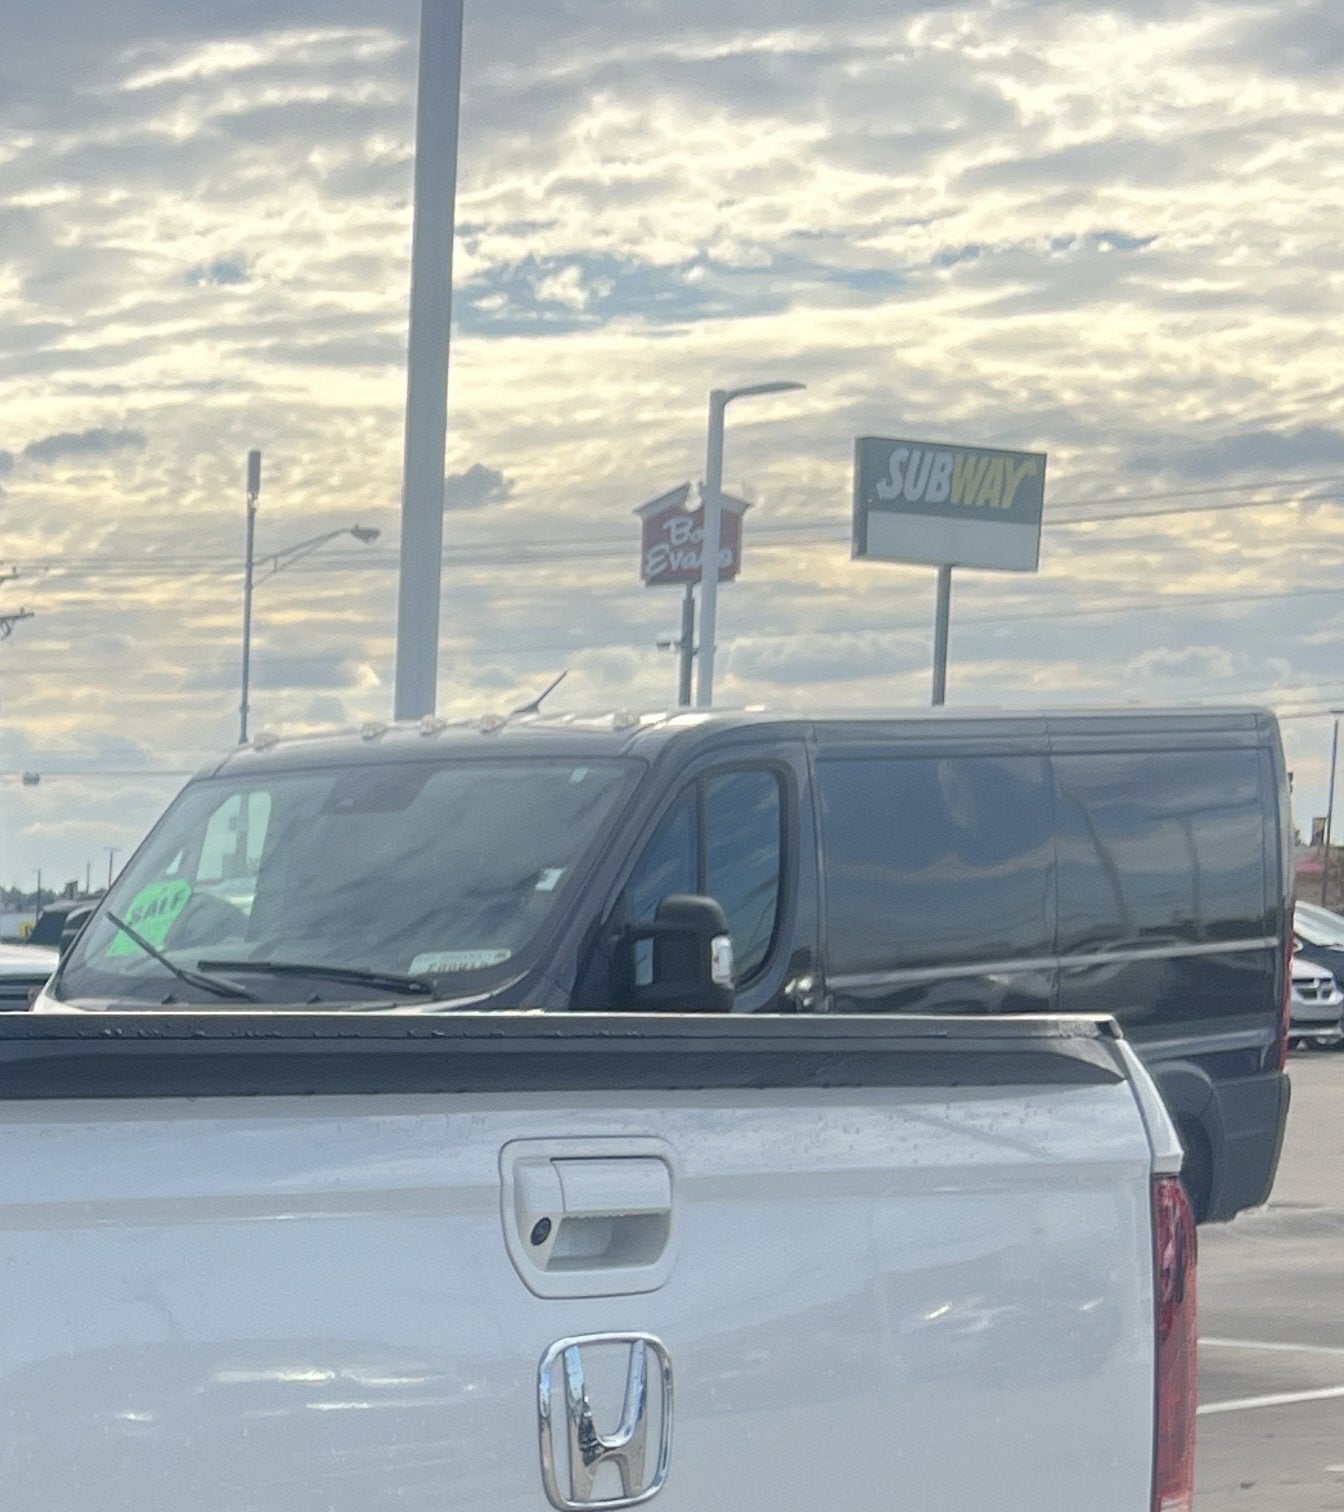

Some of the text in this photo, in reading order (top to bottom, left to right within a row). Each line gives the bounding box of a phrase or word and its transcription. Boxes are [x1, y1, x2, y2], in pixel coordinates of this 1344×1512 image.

[876, 448, 1037, 509] SUBWAY
[662, 515, 705, 545] Bo
[645, 543, 733, 577] Evas
